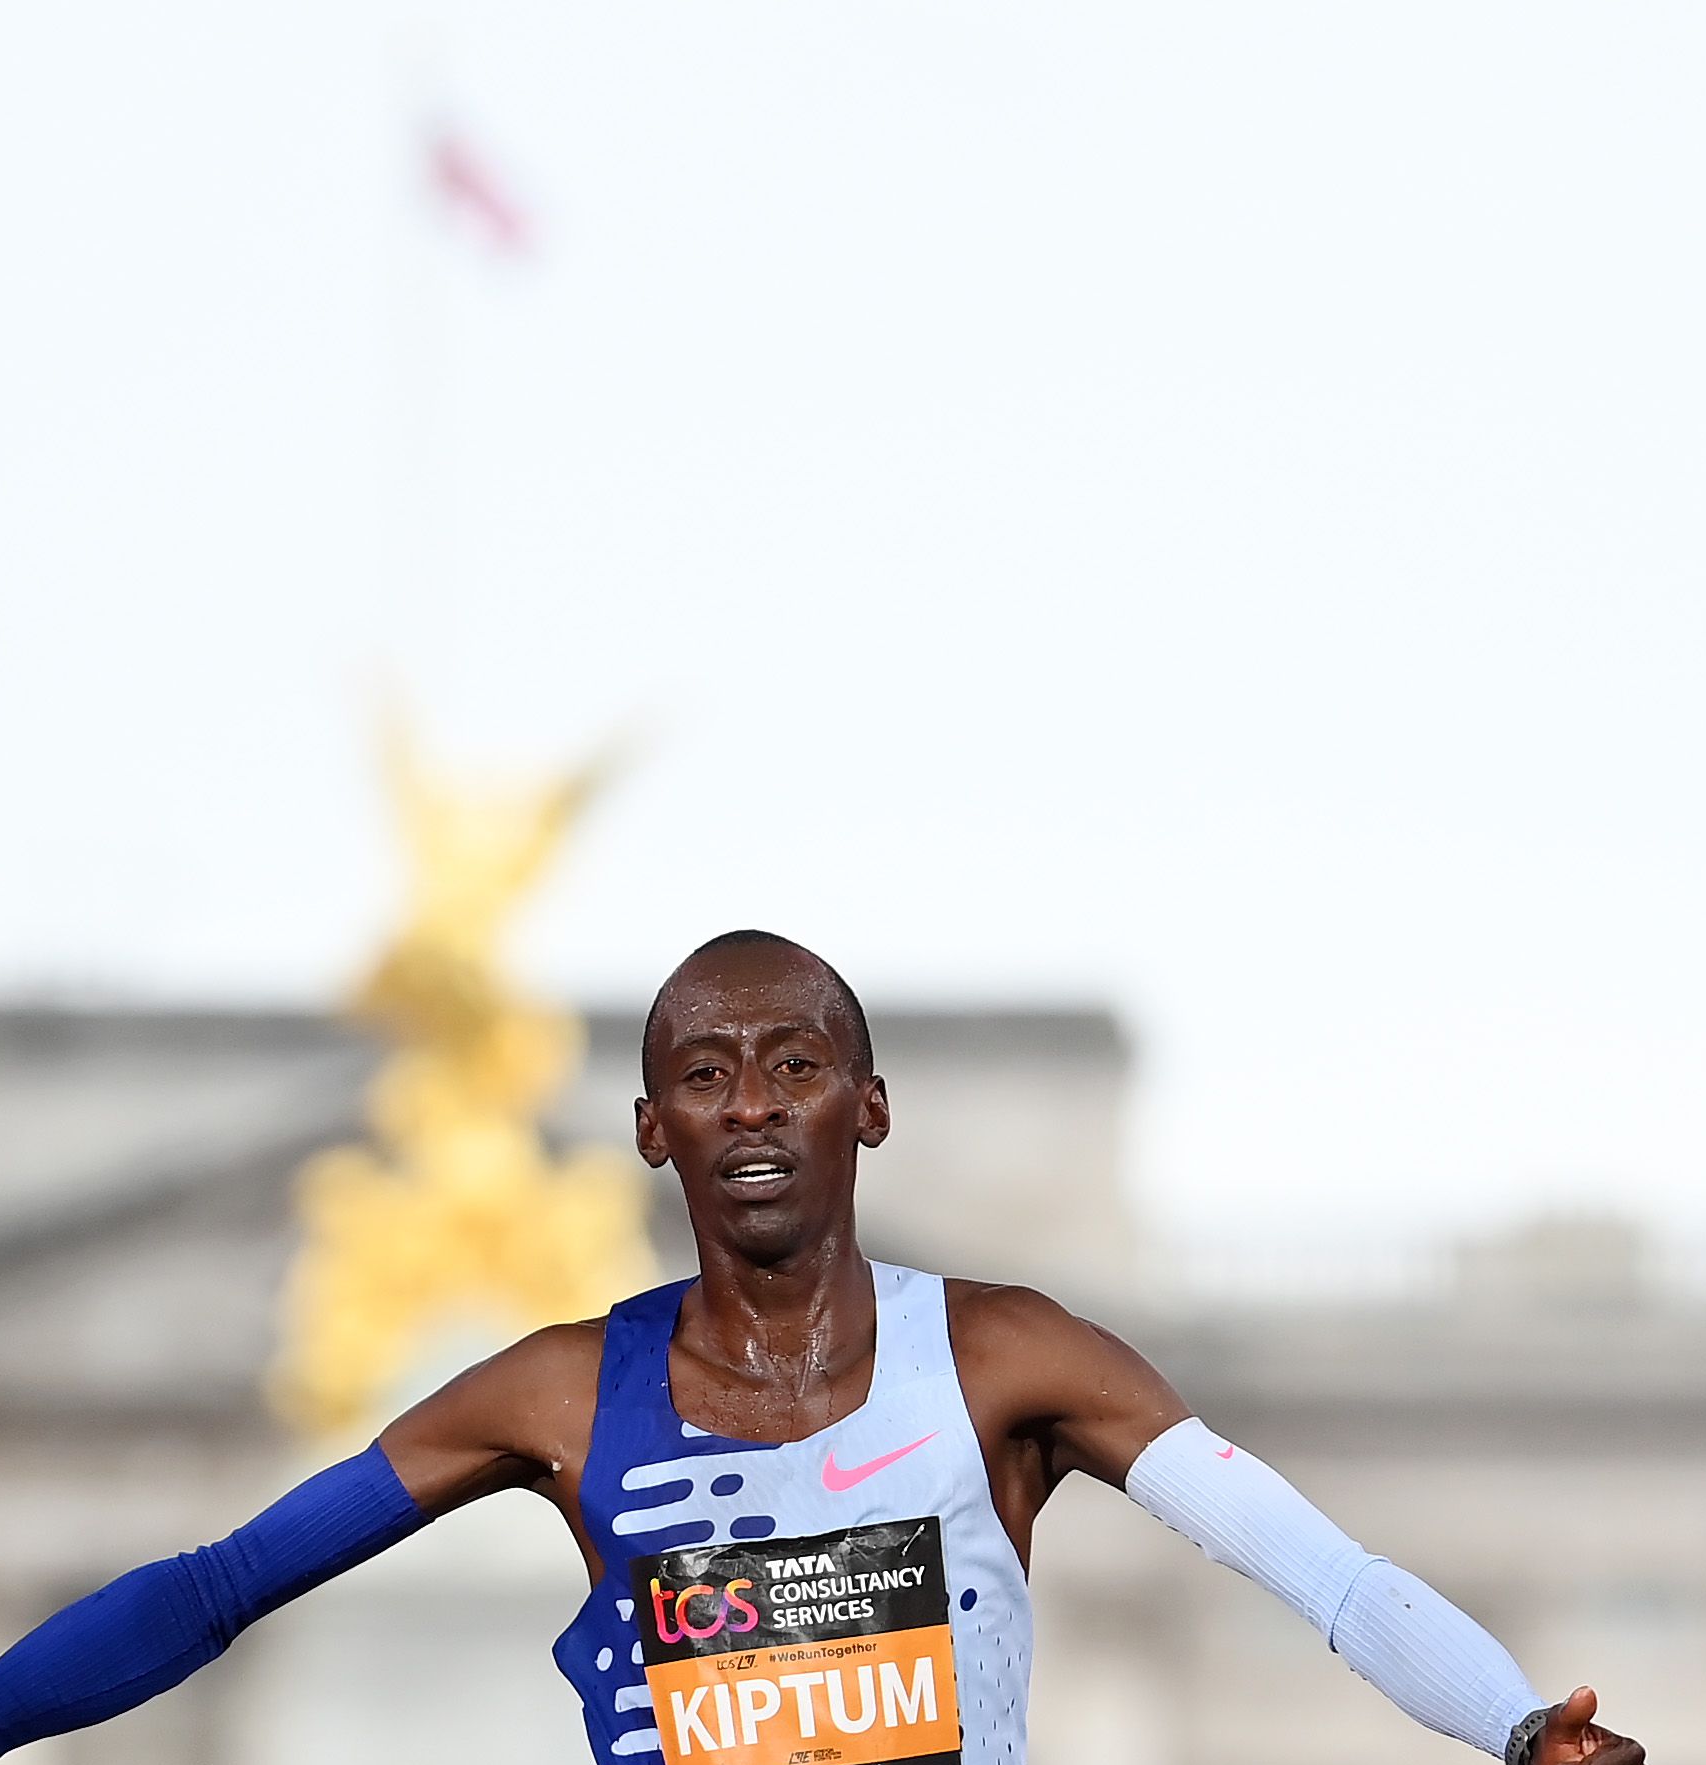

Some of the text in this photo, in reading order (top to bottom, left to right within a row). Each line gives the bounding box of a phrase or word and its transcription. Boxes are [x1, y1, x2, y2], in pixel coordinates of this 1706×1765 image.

[765, 1553, 836, 1580] TATA
[769, 1565, 926, 1604] CONSULTANCY
[649, 1577, 760, 1644] tcs
[772, 1598, 875, 1629] SERVICES
[769, 1642, 878, 1663] #WeRunTogether
[669, 1655, 939, 1758] KIPTUM
